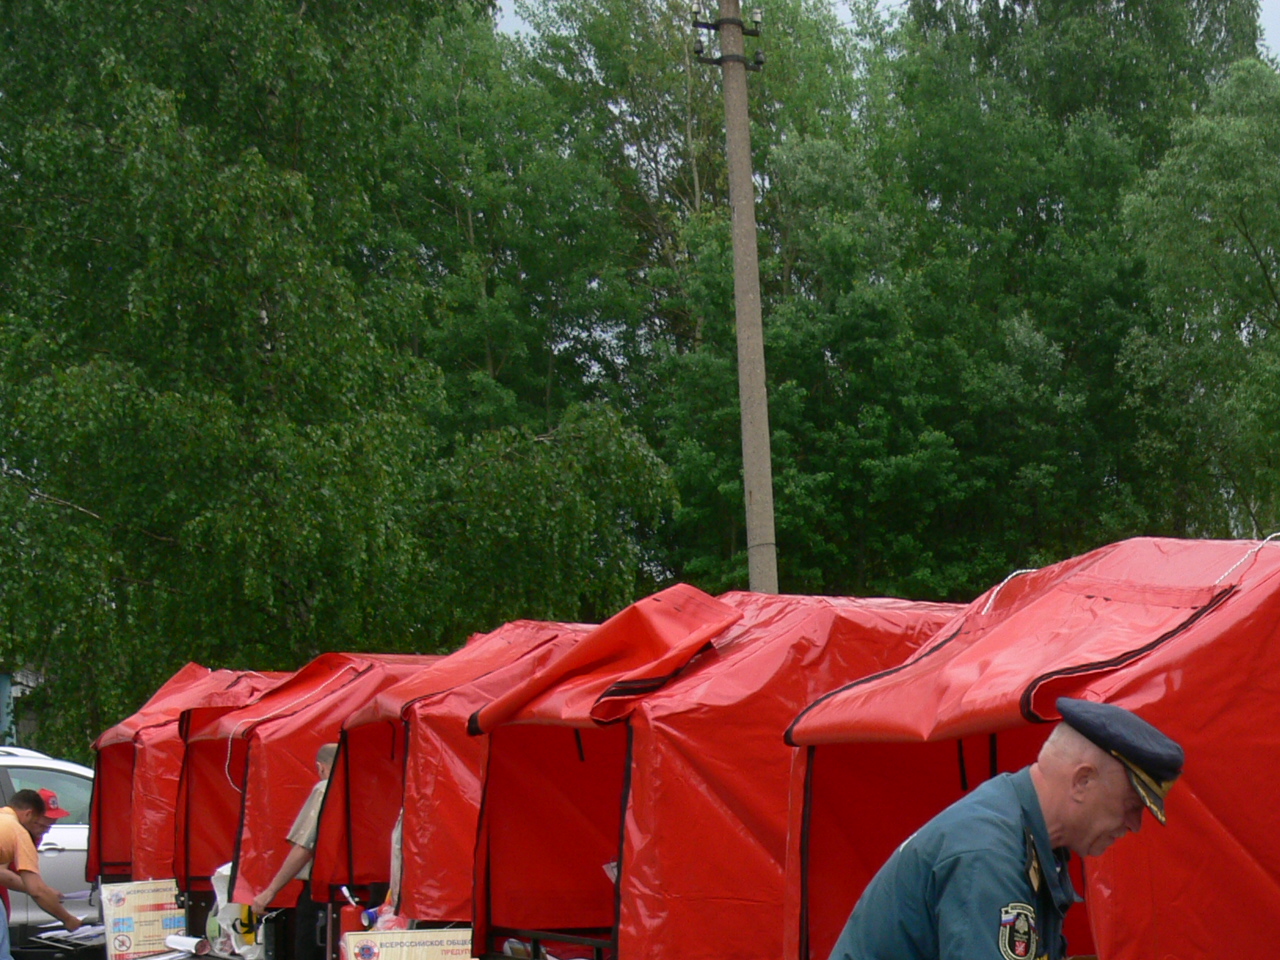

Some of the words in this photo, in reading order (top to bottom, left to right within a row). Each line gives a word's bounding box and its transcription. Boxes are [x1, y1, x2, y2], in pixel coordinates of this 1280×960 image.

[380, 939, 445, 949] ВСЕРОССИЙСКОЕ
[446, 938, 472, 946] ОБЩЕС
[441, 948, 471, 956] ПРЕДУП
